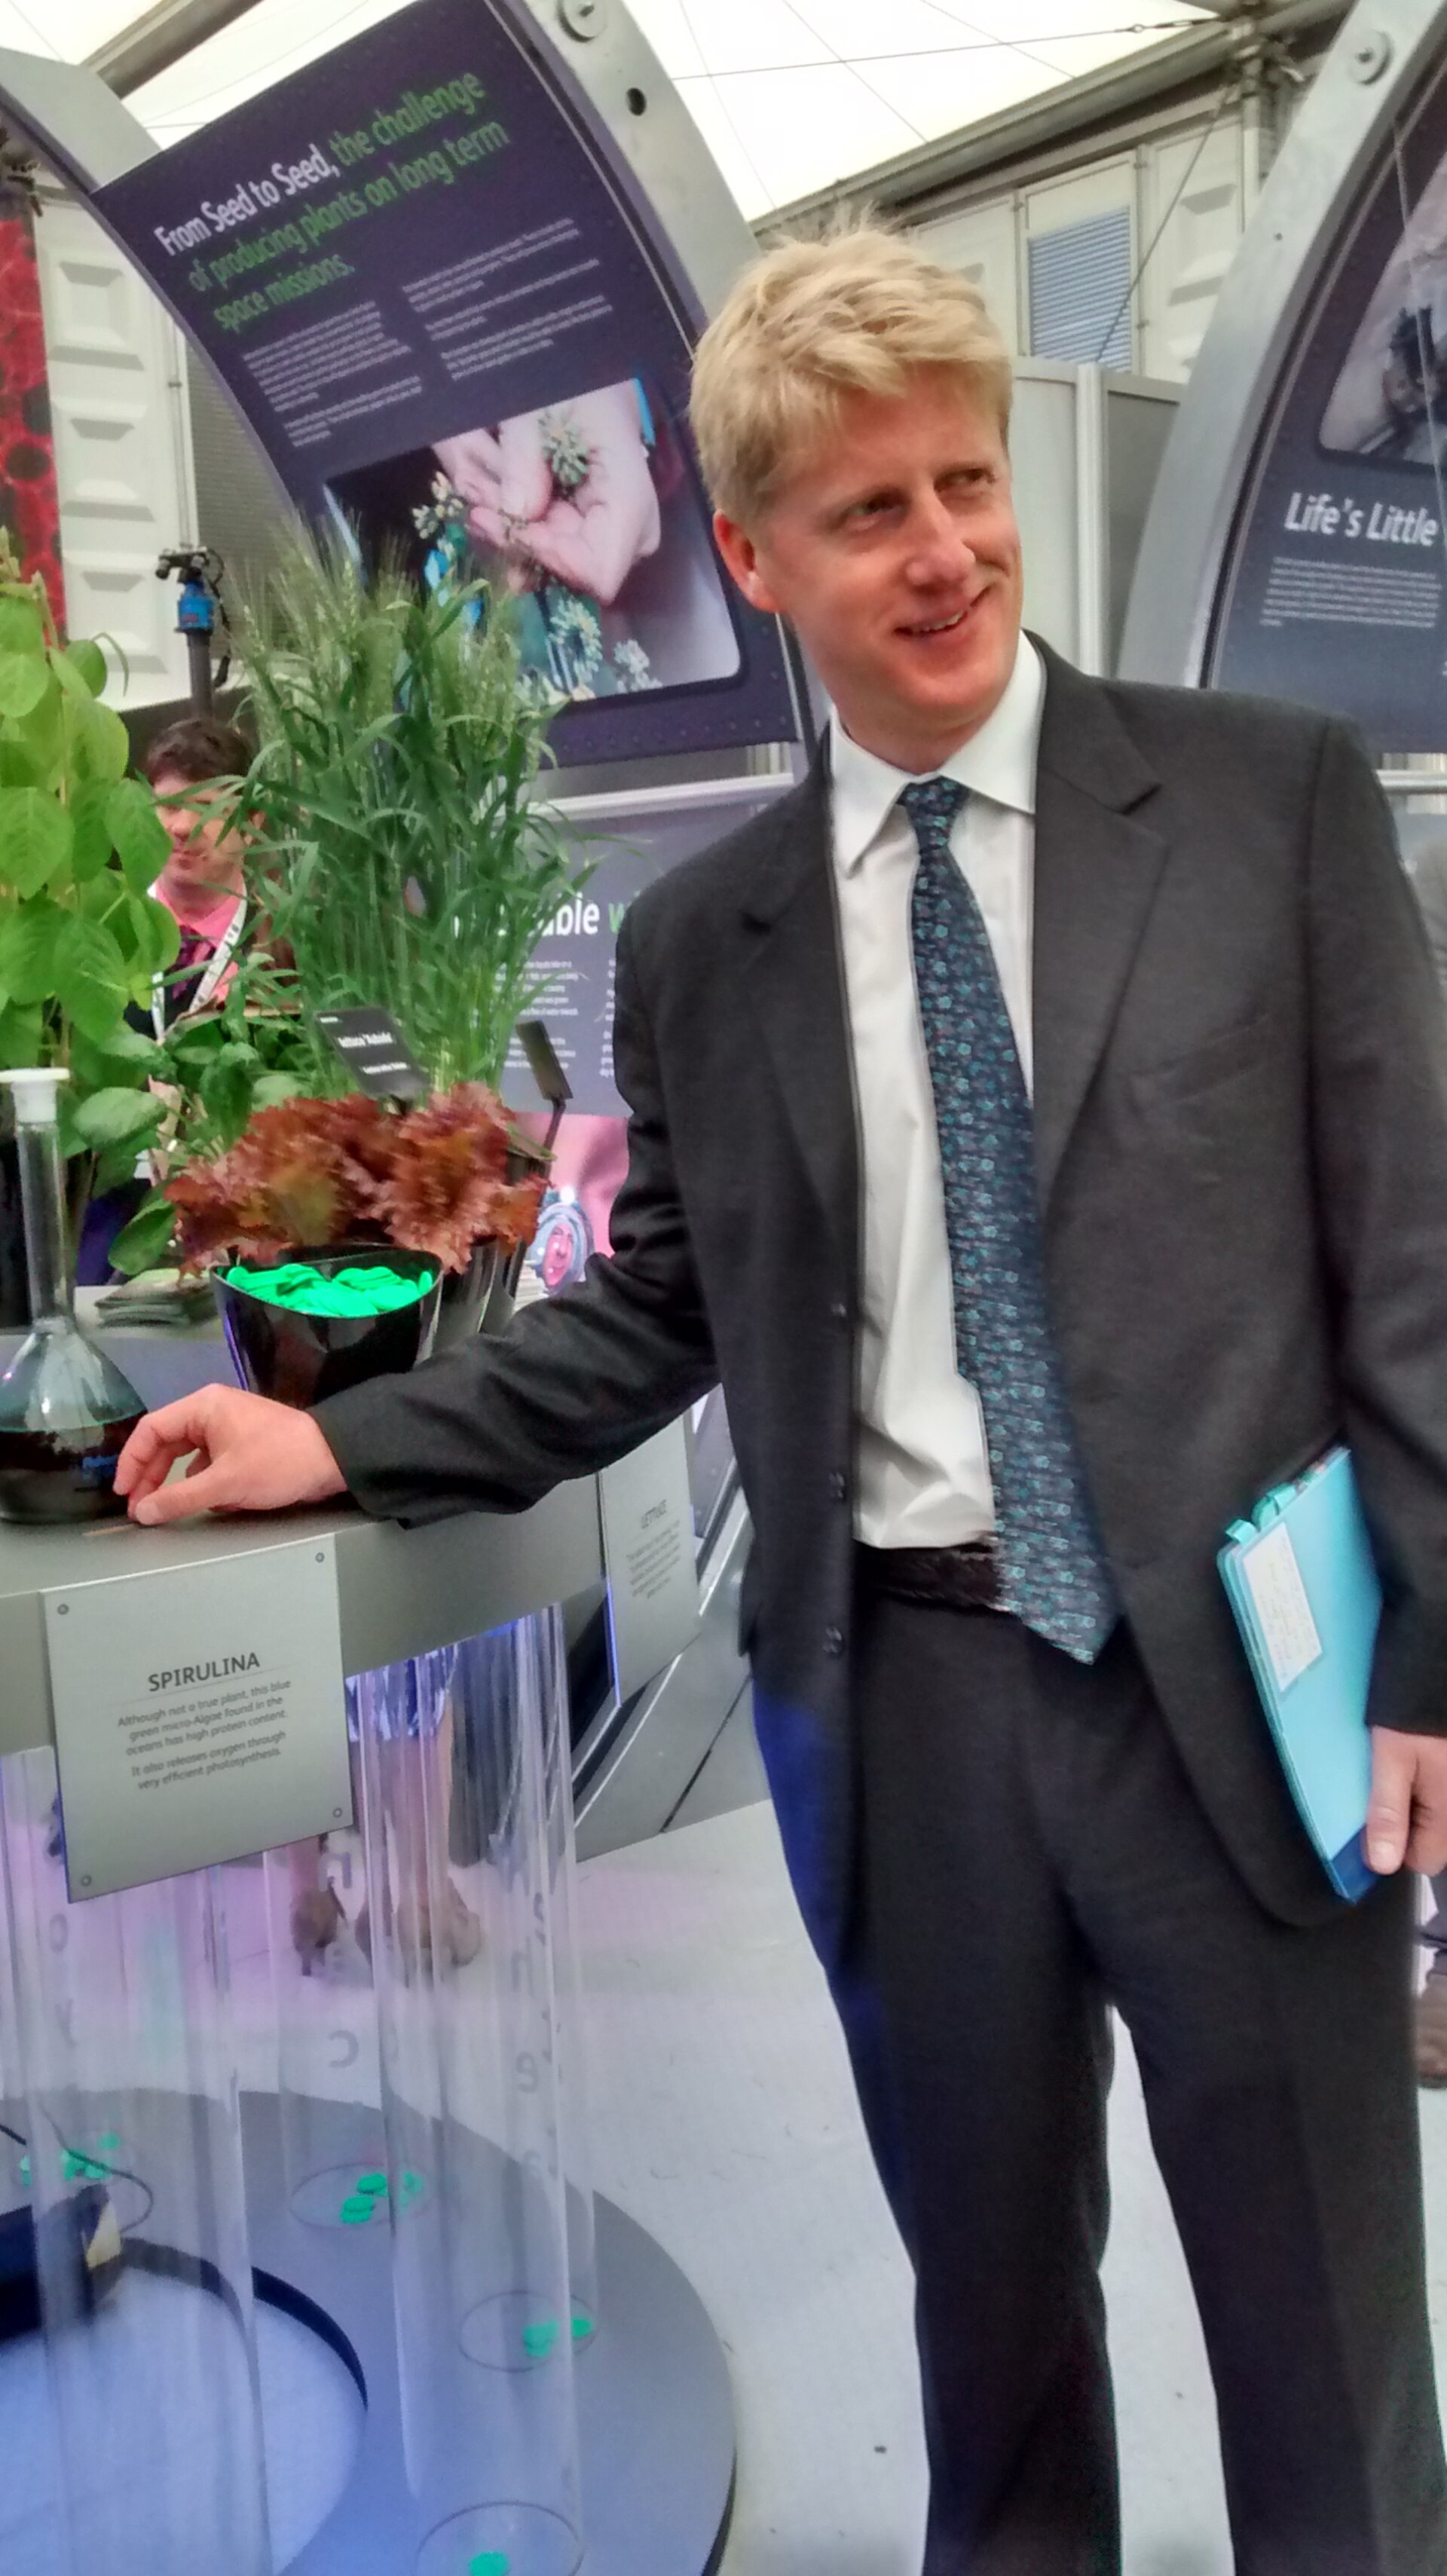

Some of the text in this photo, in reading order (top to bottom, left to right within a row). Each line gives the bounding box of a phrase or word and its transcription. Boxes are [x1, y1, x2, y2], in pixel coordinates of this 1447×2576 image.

[153, 72, 486, 257] From Seed to Seed, the challenge
[188, 121, 511, 292] of producing plants on long term
[213, 291, 269, 334] space
[265, 254, 355, 305] missions.
[1284, 491, 1439, 547] Life's Little
[148, 1652, 261, 1692] SPIRULINA
[118, 1680, 291, 1727] Although not a true plant, this blue
[129, 1696, 283, 1742] green micro-Algae found in the
[126, 1739, 164, 1757] oceans
[164, 1734, 185, 1746] has
[185, 1728, 209, 1742] high
[210, 1719, 246, 1738] protein
[131, 1730, 287, 1777] It also releases oxygen through
[138, 1777, 160, 1791] very
[162, 1765, 204, 1785] efficient
